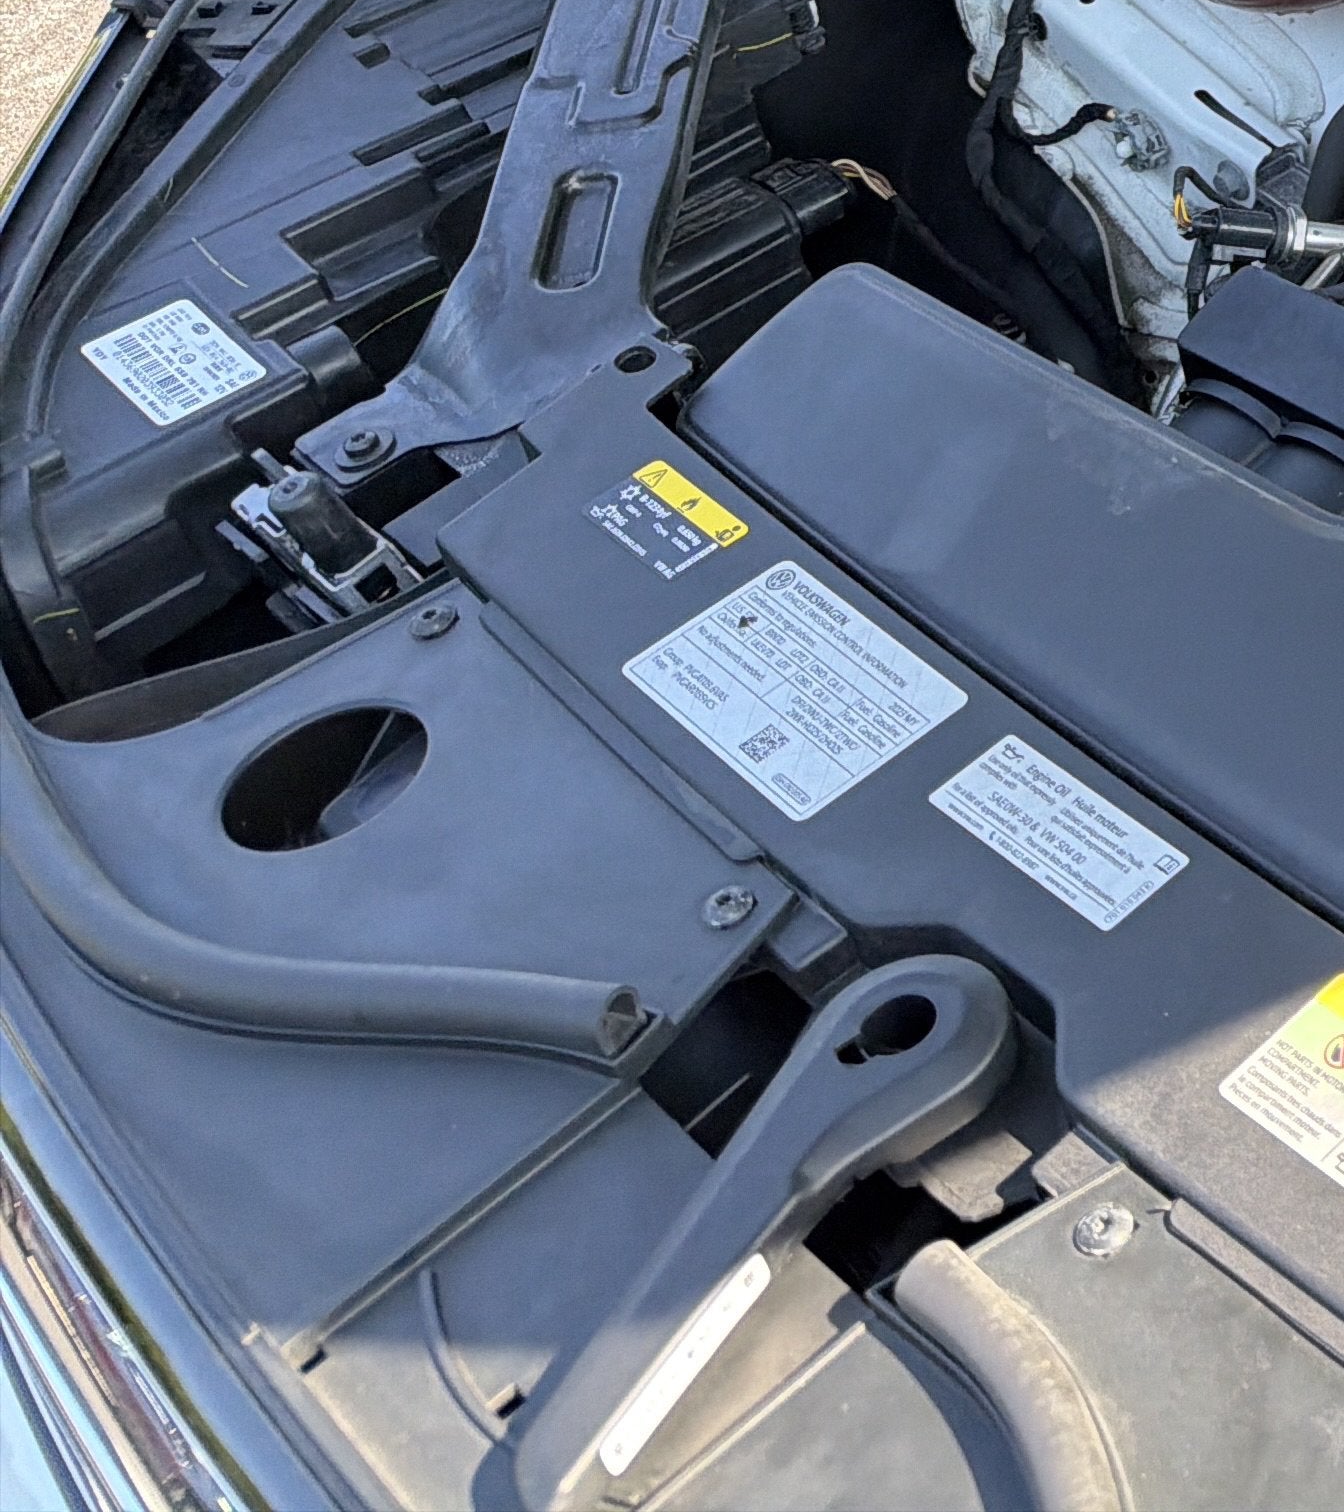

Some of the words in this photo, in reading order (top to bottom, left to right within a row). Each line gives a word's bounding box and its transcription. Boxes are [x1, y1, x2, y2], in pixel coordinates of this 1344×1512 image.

[121, 376, 142, 394] Made
[138, 393, 149, 401] in
[145, 399, 171, 421] Mexico
[745, 590, 780, 616] Conforms
[772, 612, 786, 622] to
[790, 580, 851, 626] VOLKSWAGEN
[695, 625, 709, 635] No
[779, 590, 808, 611] VEHICLE
[802, 608, 837, 633] EMISSION
[831, 630, 865, 655] CONTROL
[859, 652, 908, 689] INFORMATION
[855, 724, 888, 749] Gasoline
[870, 712, 904, 738] Gasoline
[1022, 763, 1060, 790] Engine
[1052, 782, 1072, 797] Oil
[1070, 795, 1099, 817] Huile
[1093, 812, 1130, 839] moteur
[1037, 827, 1059, 844] VW
[1114, 846, 1127, 856] de
[1257, 1054, 1289, 1079] MOVING
[1274, 1038, 1293, 1053] HOT
[1289, 1049, 1315, 1068] PARTS
[1311, 1065, 1323, 1075] IN
[1236, 1073, 1248, 1083] le
[1243, 1080, 1295, 1119] compartiment
[1244, 1064, 1290, 1099] Composants
[1299, 1104, 1326, 1126] chauds
[1323, 1121, 1344, 1138] dans
[1249, 1100, 1261, 1110] en
